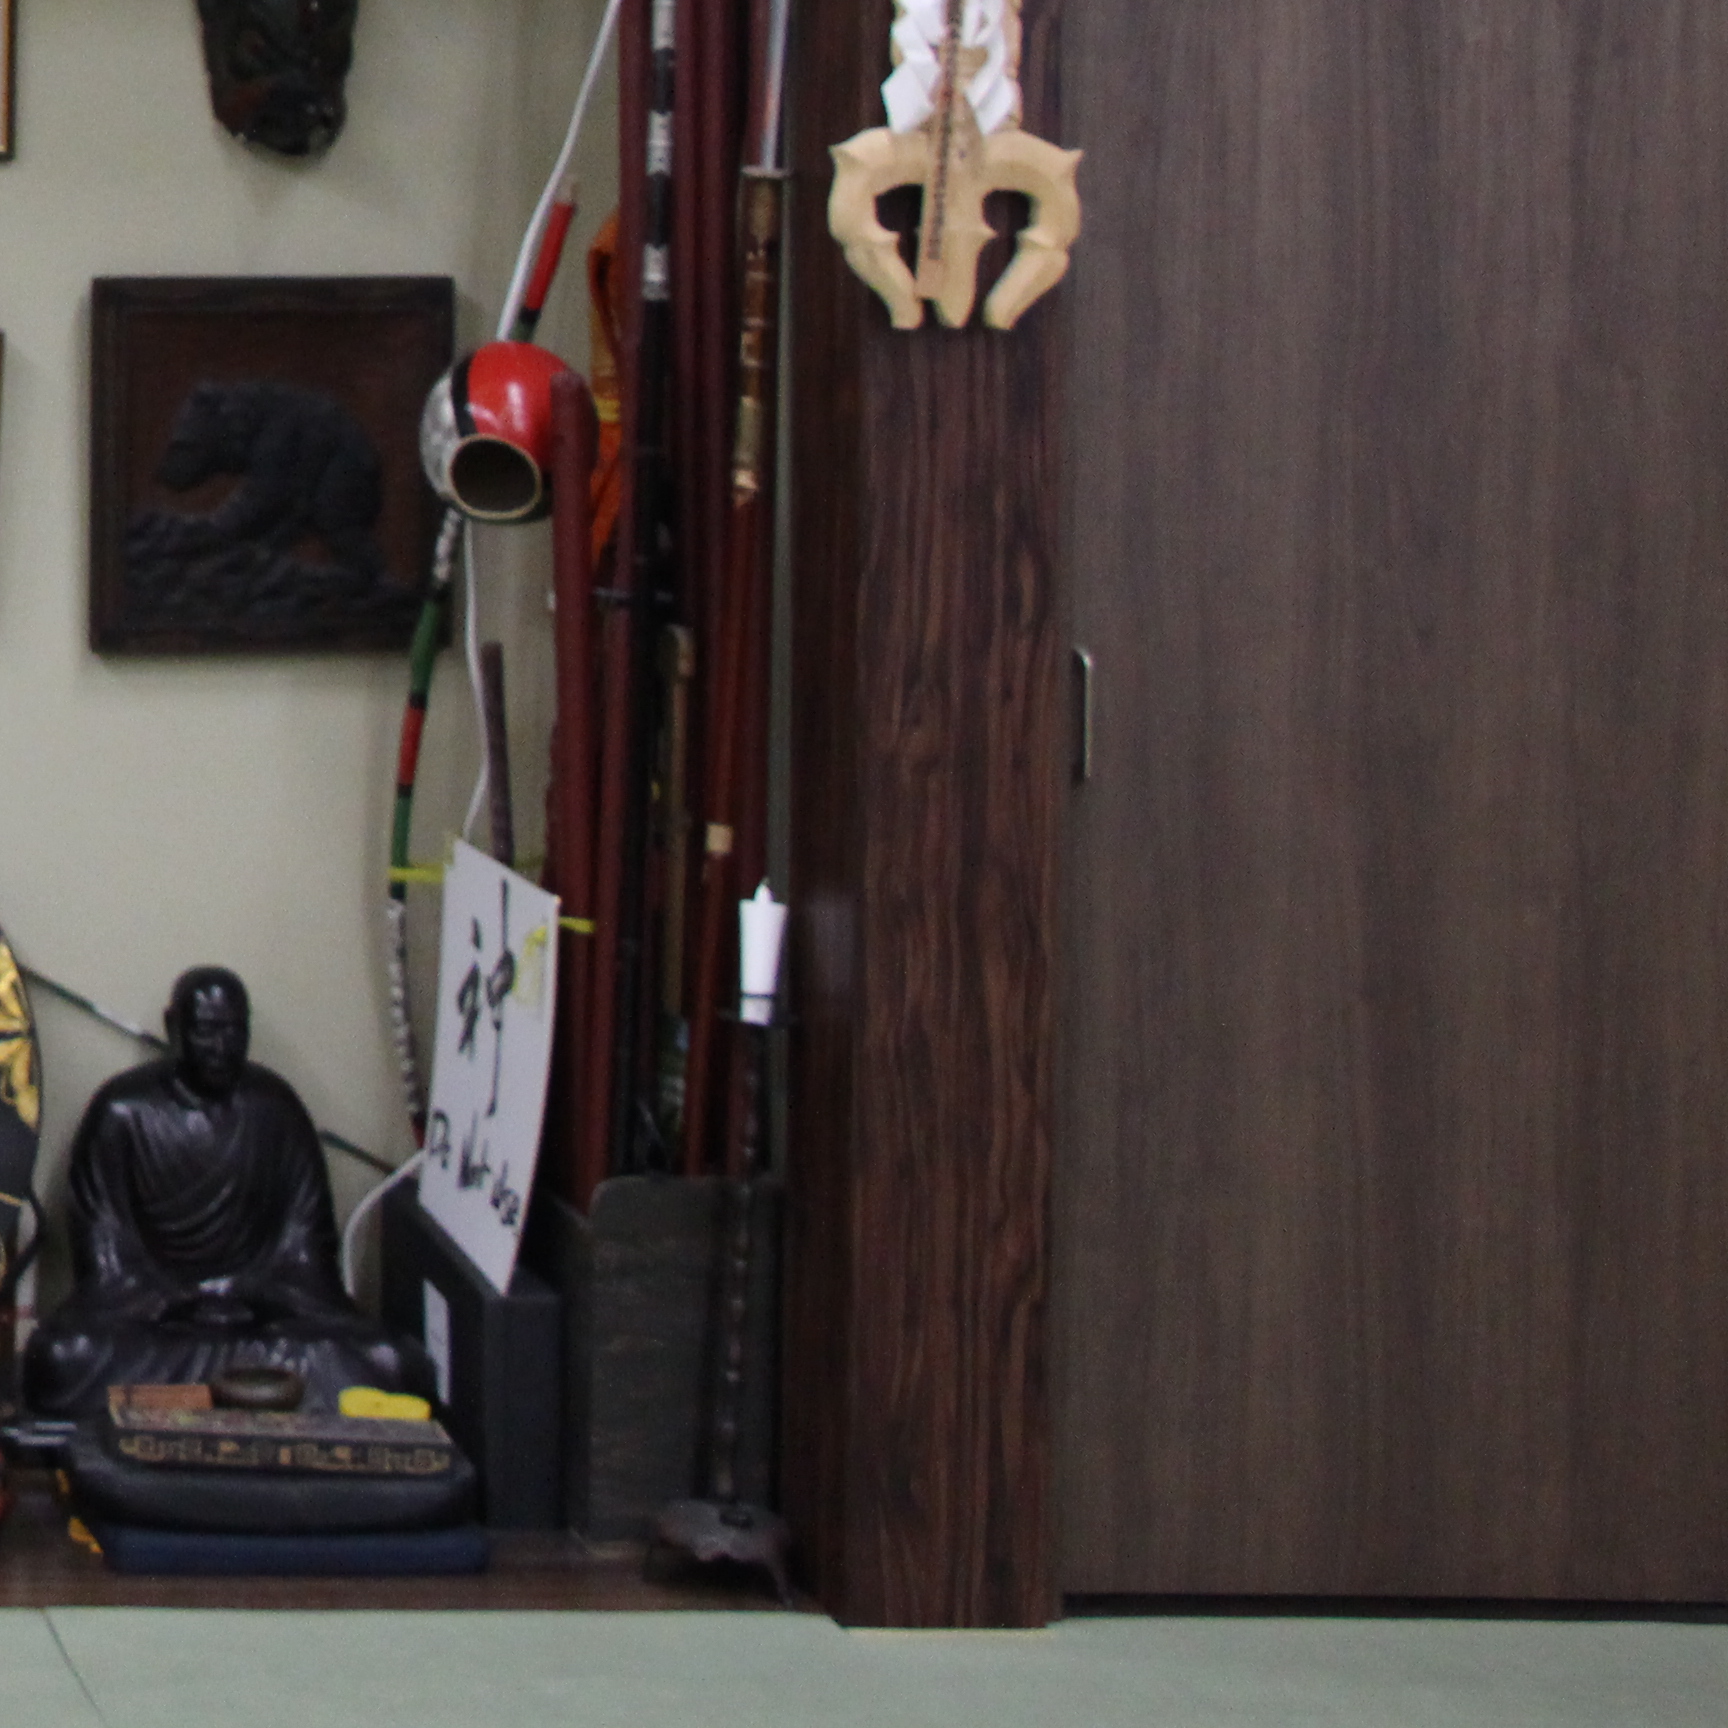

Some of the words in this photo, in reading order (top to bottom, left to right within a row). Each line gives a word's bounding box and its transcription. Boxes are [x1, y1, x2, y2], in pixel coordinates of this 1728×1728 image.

[456, 878, 517, 1118] 神
[426, 1109, 452, 1170] Do
[458, 1111, 491, 1191] Not
